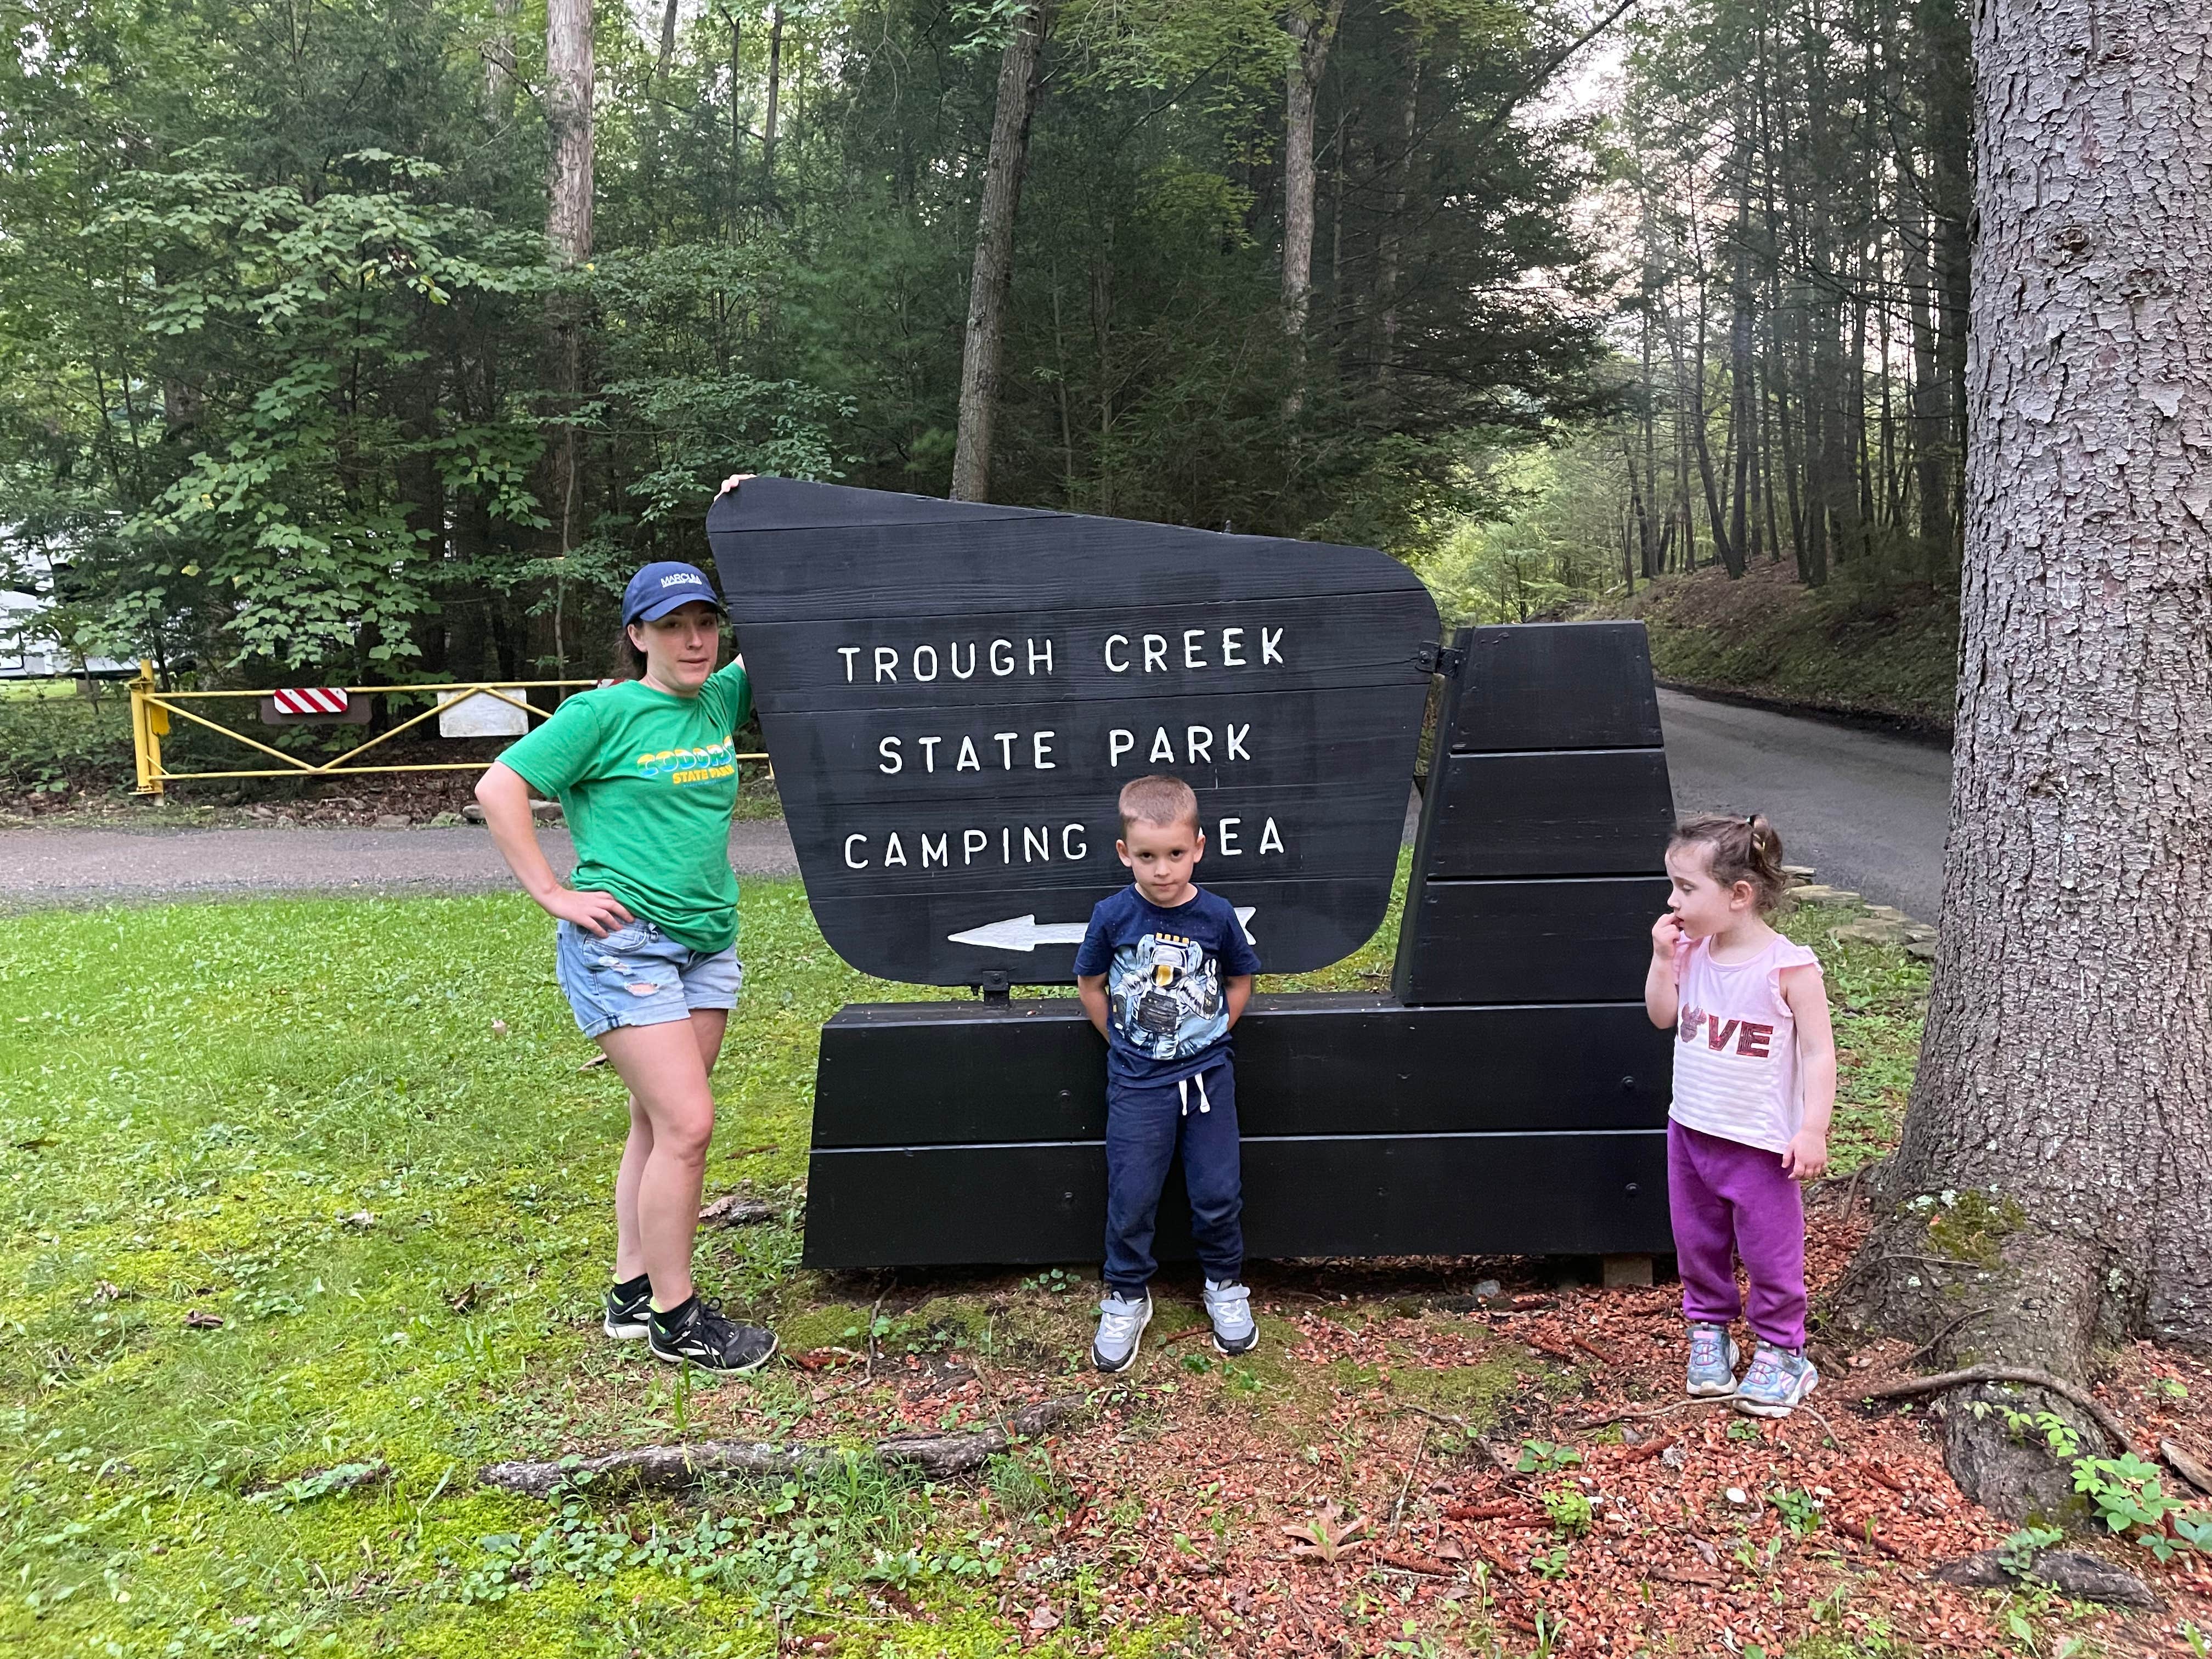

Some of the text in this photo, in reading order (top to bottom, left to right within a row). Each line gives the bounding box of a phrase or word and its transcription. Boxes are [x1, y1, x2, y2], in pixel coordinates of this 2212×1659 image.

[837, 627, 1284, 684] TROUGH CREEK
[878, 723, 1251, 774] STATE PARK
[672, 769, 709, 784] STATE
[844, 816, 1285, 870] CAMPING EA
